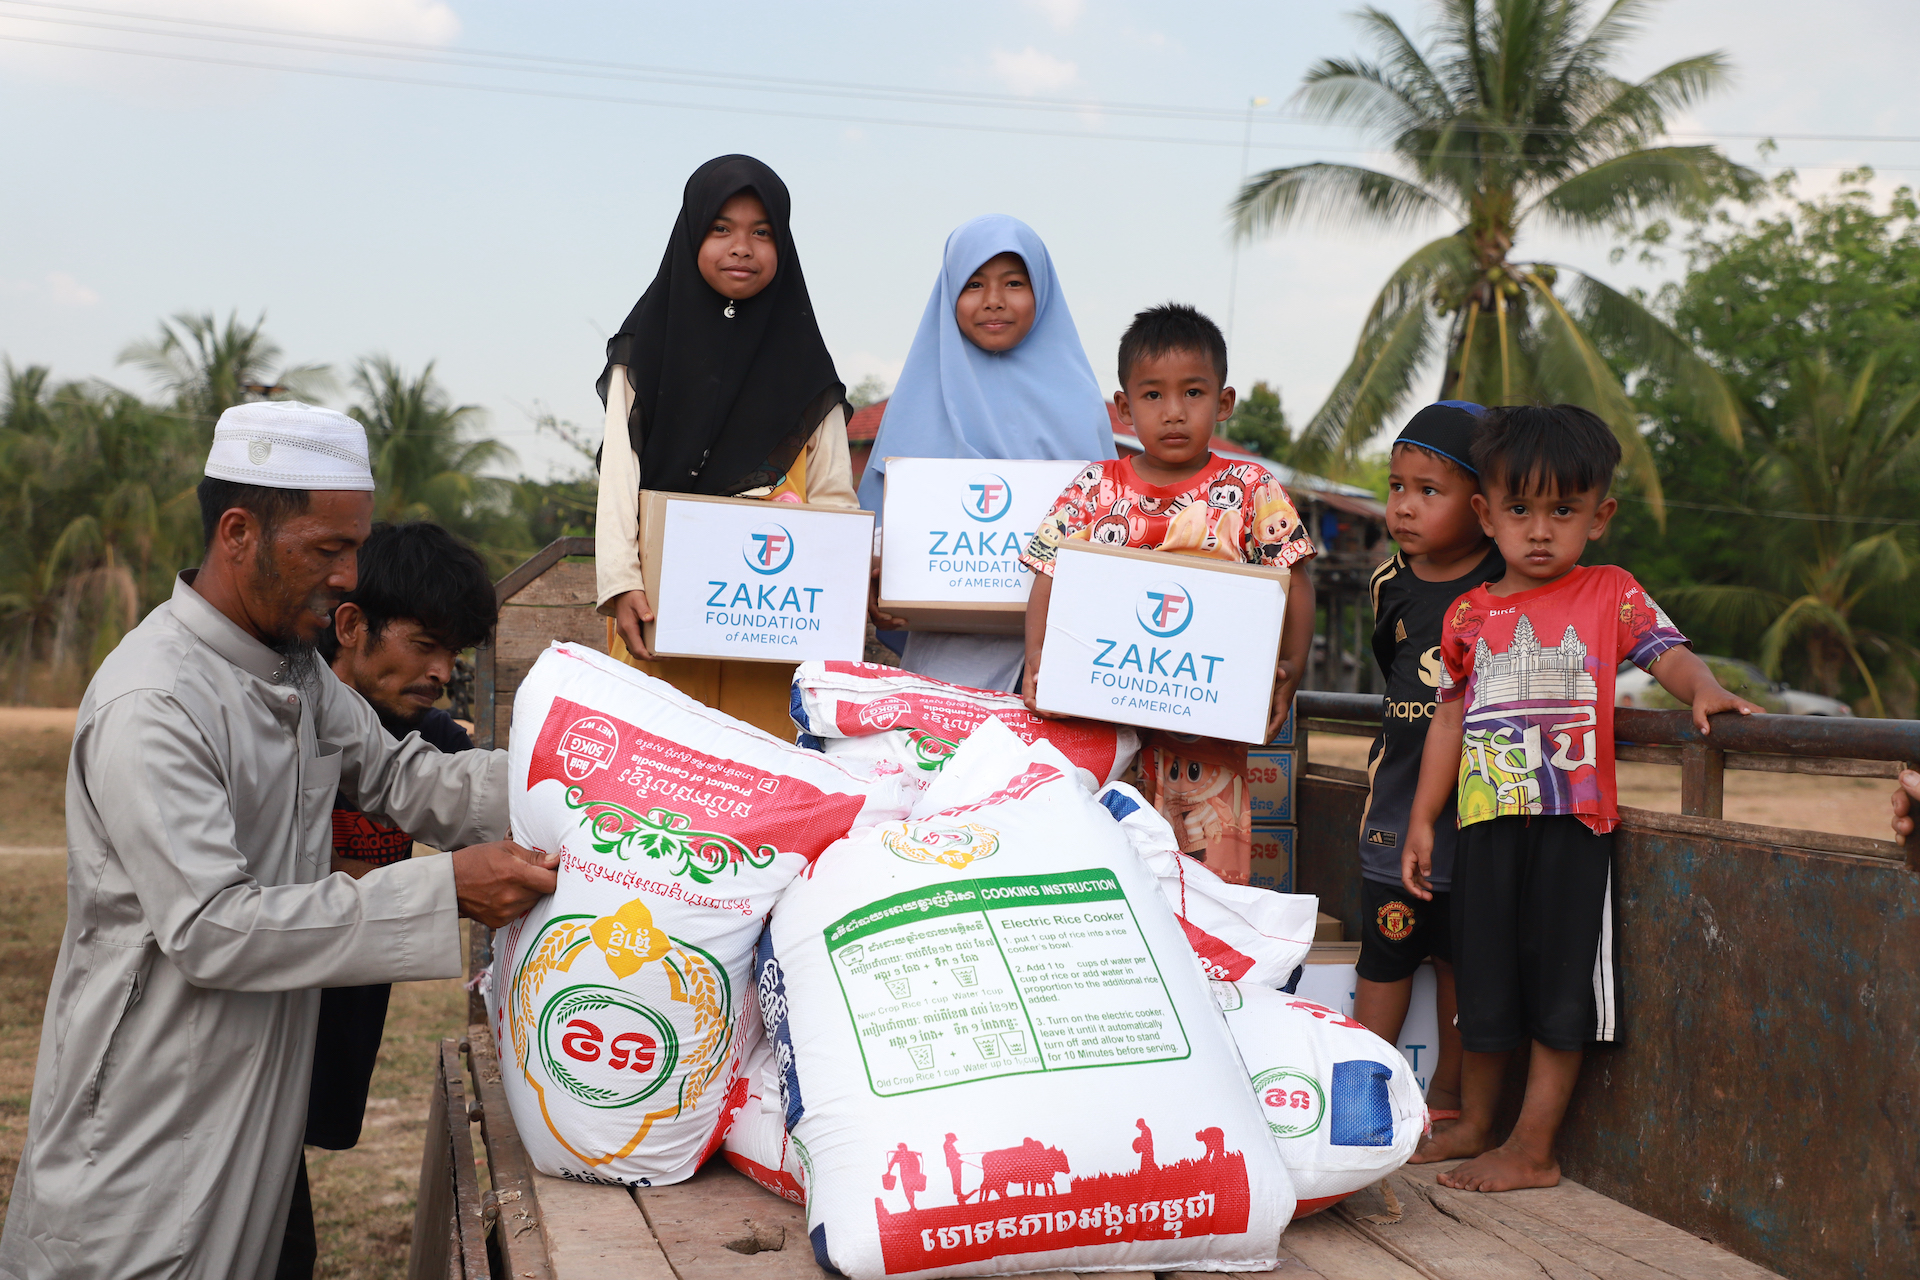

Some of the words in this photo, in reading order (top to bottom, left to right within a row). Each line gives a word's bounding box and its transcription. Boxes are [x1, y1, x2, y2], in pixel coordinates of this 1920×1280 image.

[929, 531, 1032, 556] ZAKA
[929, 559, 1029, 573] FOUNDATIO
[949, 577, 963, 588] of
[964, 578, 1022, 588] AMERICA
[706, 581, 824, 613] ZAKAT
[705, 611, 820, 631] FOUNDATION
[725, 631, 740, 642] of
[741, 632, 798, 645] AMERICA
[1093, 638, 1225, 684] ZAKAT
[1090, 671, 1219, 704] FOUNDATION
[923, 704, 974, 718] Cambodia
[1111, 693, 1128, 706] of
[1128, 695, 1192, 717] AMERICA
[578, 720, 596, 731] WT
[597, 724, 613, 740] NET
[570, 738, 605, 758] 50KG
[631, 753, 689, 780] Cambodia
[690, 772, 705, 784] of
[705, 777, 753, 797] Product
[350, 833, 404, 849] adidas
[981, 884, 1040, 900] COOKING
[1040, 878, 1118, 896] INSTRUCTION
[1380, 902, 1412, 918] MANCHESTER
[1001, 916, 1051, 930] Electric
[1053, 914, 1082, 925] Rice
[1083, 911, 1125, 923] Cooker
[1014, 935, 1028, 946] put
[1039, 932, 1056, 943] cup
[1058, 930, 1067, 940] of
[1069, 929, 1086, 938] rice
[1088, 928, 1103, 937] into
[1112, 927, 1127, 936] rice
[1385, 929, 1408, 938] UNITED
[1007, 942, 1047, 954] cooker's
[1049, 941, 1074, 950] bowl.
[1027, 963, 1046, 972] Add
[1076, 960, 1098, 969] cups
[1100, 958, 1109, 966] of
[1110, 957, 1133, 965] water
[1134, 956, 1146, 965] per
[1020, 975, 1038, 984] cup
[1040, 972, 1050, 981] of
[1051, 972, 1069, 980] rice
[1082, 969, 1100, 978] add
[1100, 968, 1124, 976] water
[1125, 967, 1134, 975] in
[1023, 983, 1073, 995] proportion
[1074, 981, 1084, 990] to
[1086, 980, 1100, 988] the
[1102, 976, 1143, 987] additional
[1144, 975, 1158, 984] rice
[858, 1011, 876, 1020] New
[878, 1005, 900, 1016] Crop
[902, 1000, 921, 1010] Rice
[931, 996, 949, 1005] cup
[952, 991, 979, 1001] Water
[1028, 994, 1060, 1004] added.
[1047, 1016, 1069, 1025] Turn
[1071, 1015, 1083, 1023] on
[1085, 1013, 1100, 1022] the
[1101, 1010, 1134, 1021] electric
[1040, 1028, 1066, 1038] leave
[1076, 1025, 1097, 1034] until
[1107, 1020, 1163, 1033] automatically
[1044, 1041, 1064, 1050] turn
[1066, 1038, 1079, 1047] off
[1082, 1037, 1099, 1046] and
[1101, 1035, 1124, 1045] allow
[1126, 1034, 1136, 1042] to
[1137, 1032, 1161, 1041] stand
[1048, 1052, 1061, 1062] for
[1064, 1051, 1076, 1060] 10
[1078, 1047, 1114, 1059] Minutes
[1116, 1045, 1145, 1056] before
[1146, 1043, 1179, 1053] serving.
[877, 1079, 892, 1088] Old
[893, 1076, 914, 1086] Crop
[916, 1072, 935, 1081] Rice
[944, 1068, 960, 1077] cup
[963, 1063, 988, 1073] Water
[991, 1061, 1002, 1070] up
[1003, 1058, 1013, 1066] to
